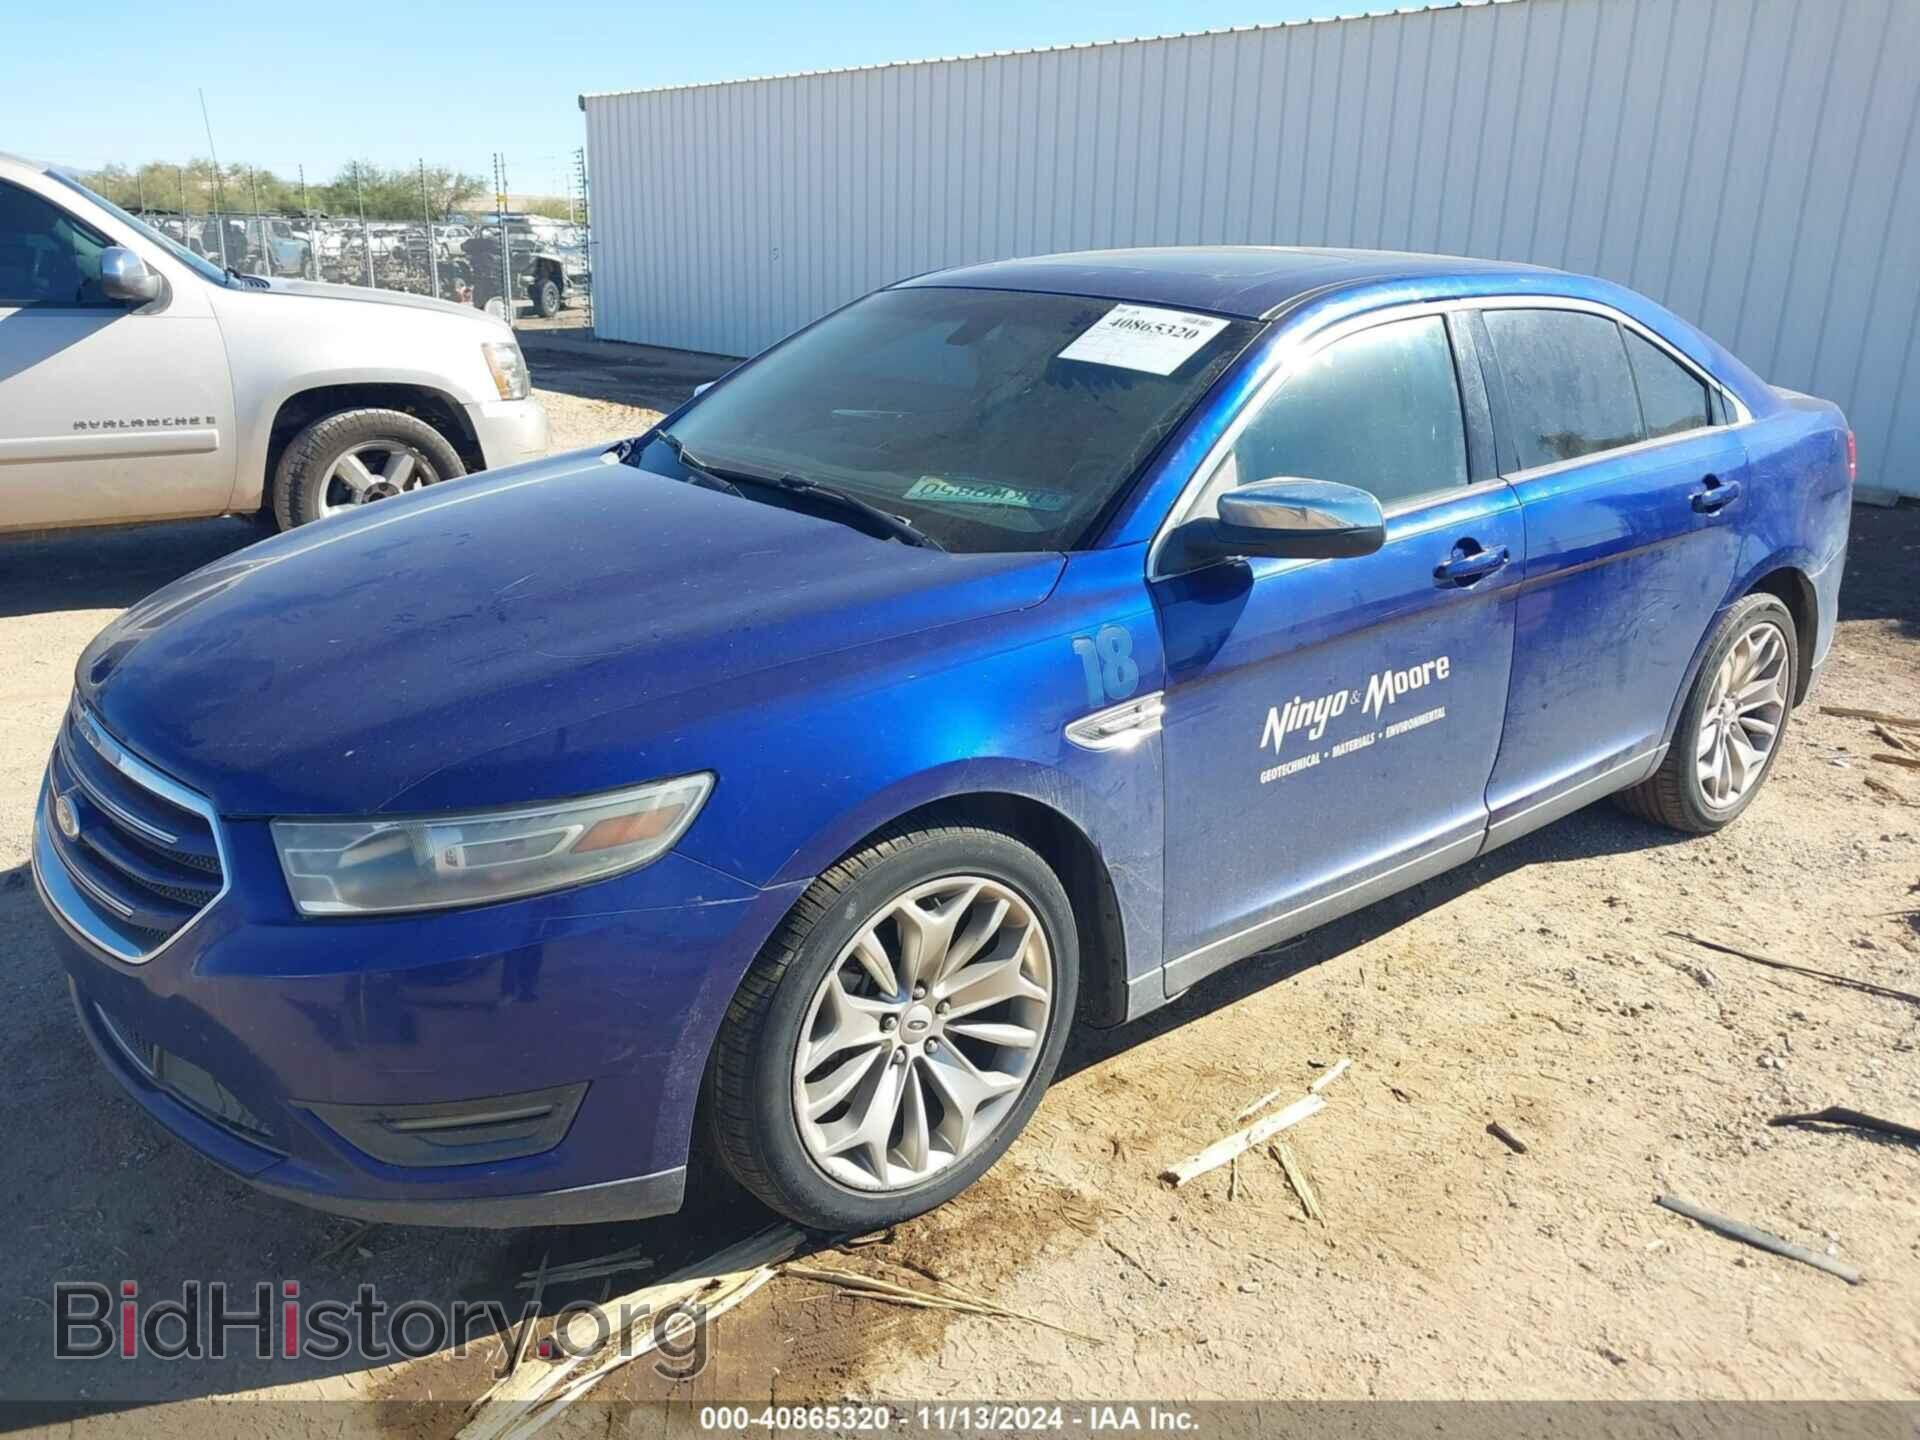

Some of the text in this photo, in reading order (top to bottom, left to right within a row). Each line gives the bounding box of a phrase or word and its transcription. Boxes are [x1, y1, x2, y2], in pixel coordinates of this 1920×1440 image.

[1109, 318, 1199, 340] 40865320
[1071, 624, 1139, 708] 18
[1259, 655, 1450, 755] Ninyo & Moore
[1260, 705, 1447, 785] GEOTECHNICAL MATERIALS ENVIRONMENTAL
